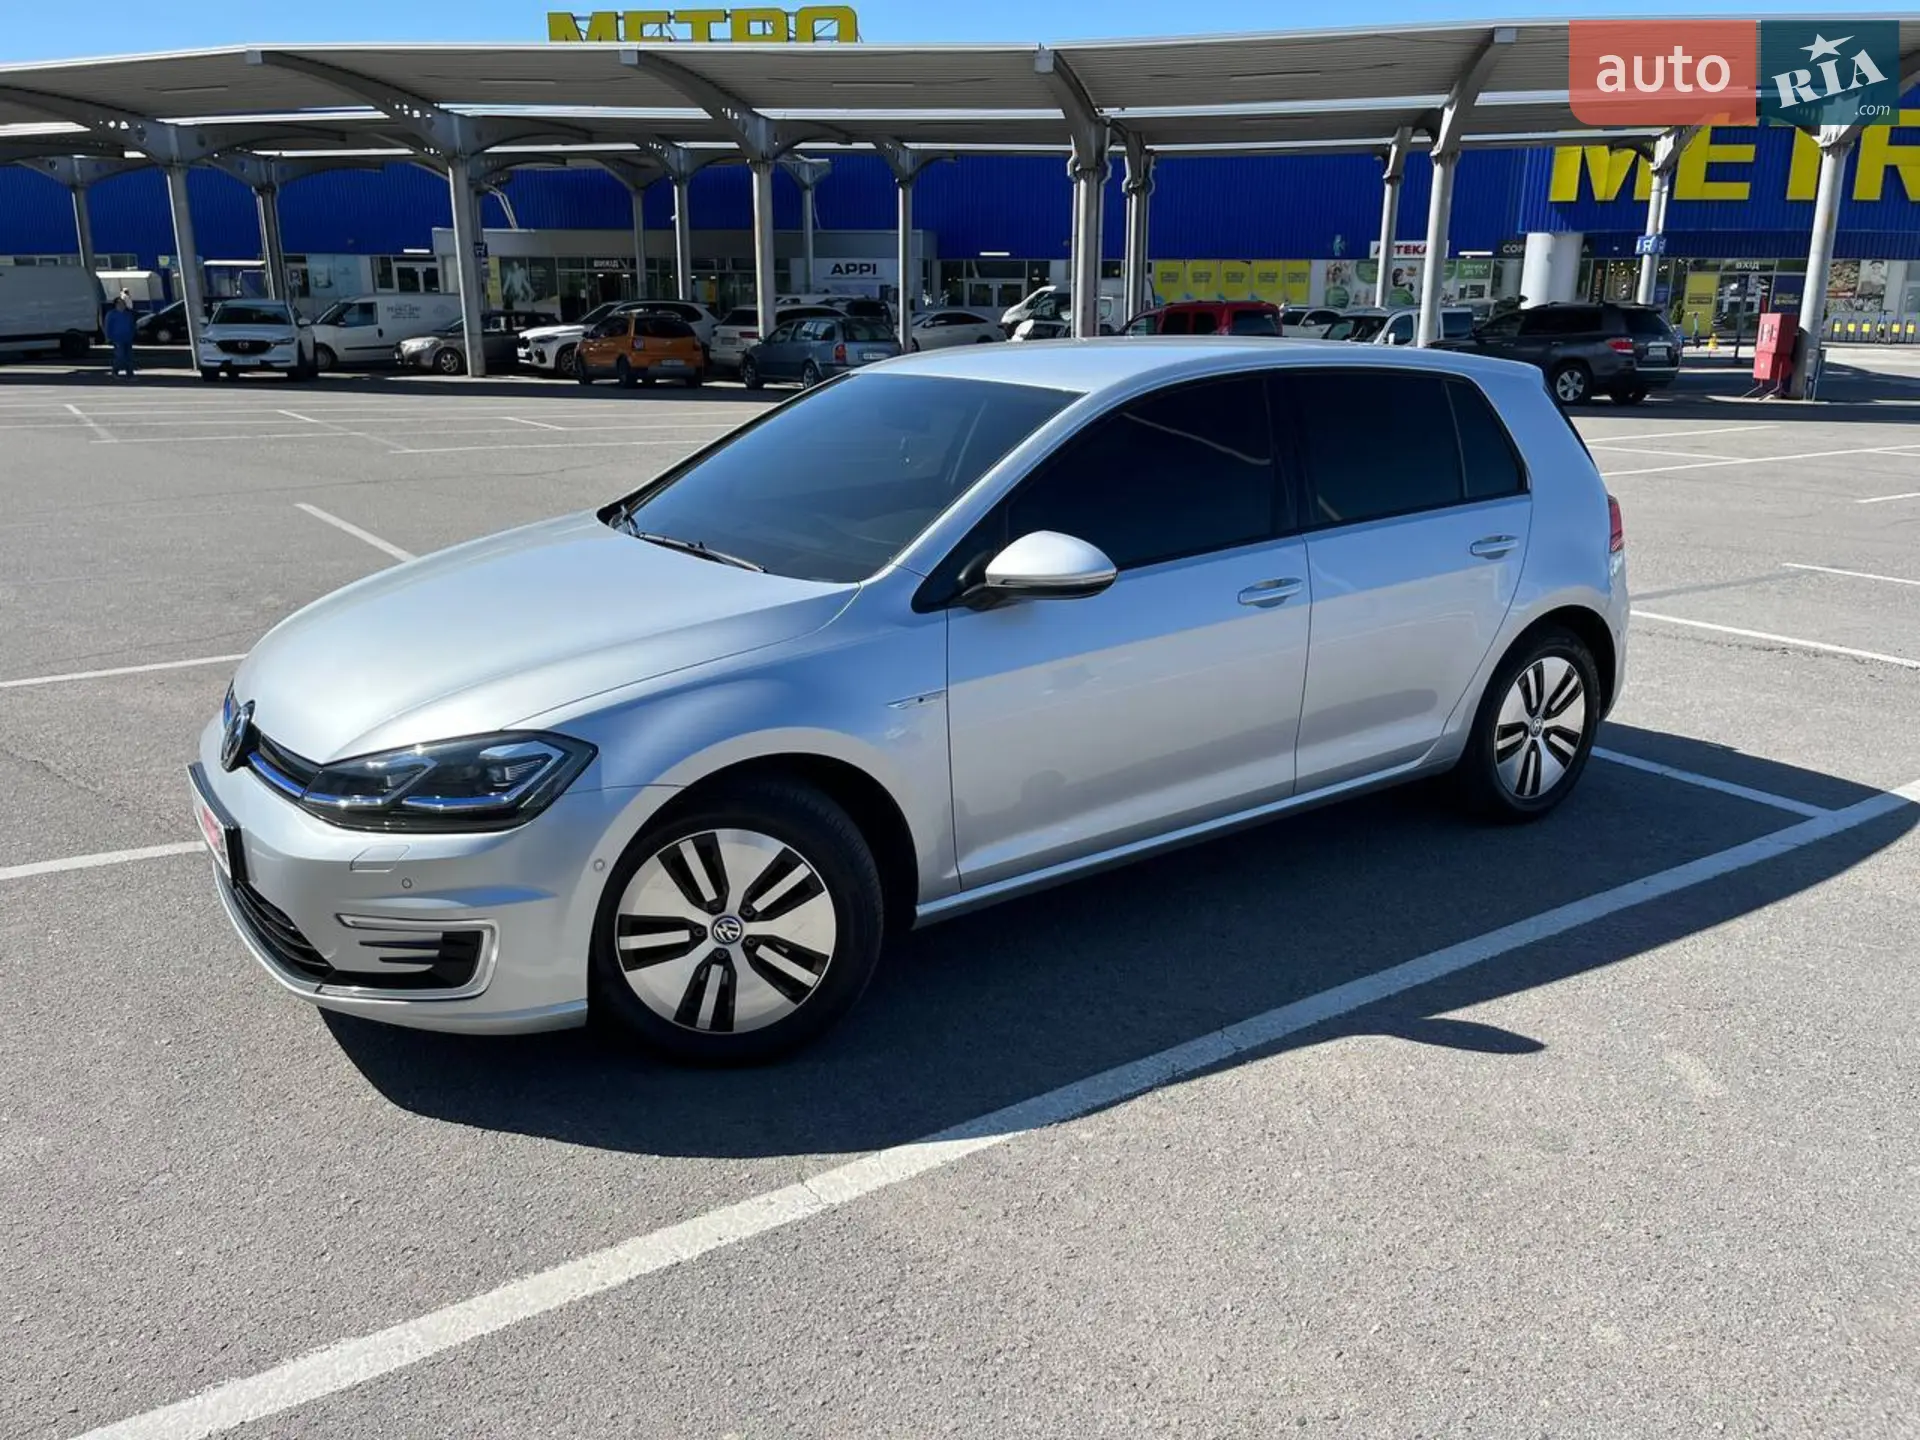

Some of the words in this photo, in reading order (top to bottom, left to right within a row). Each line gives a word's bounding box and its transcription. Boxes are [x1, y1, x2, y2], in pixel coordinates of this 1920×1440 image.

[547, 6, 857, 42] METRO
[1375, 245, 1428, 255] АТЕКА
[1735, 260, 1760, 270] ВХІД
